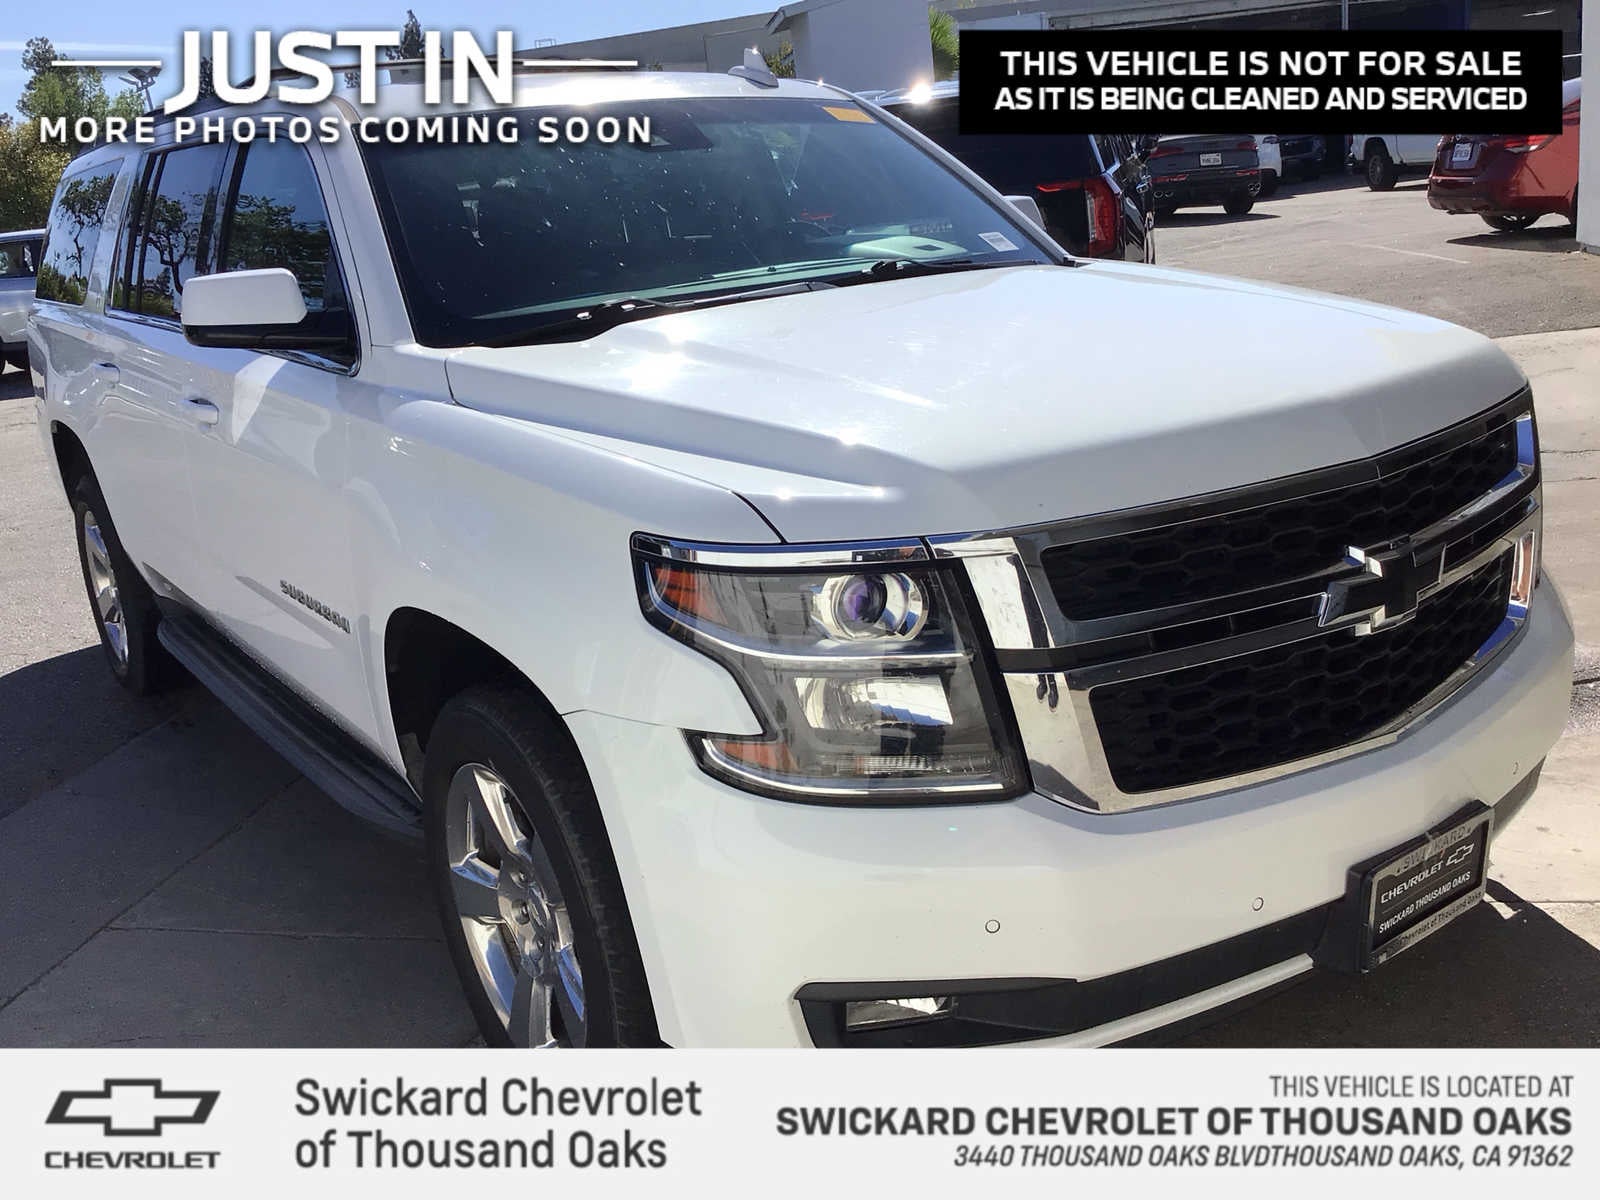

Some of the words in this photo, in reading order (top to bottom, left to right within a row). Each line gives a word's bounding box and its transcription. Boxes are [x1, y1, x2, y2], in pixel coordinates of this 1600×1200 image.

[280, 580, 351, 633] SUBURBAN
[1379, 904, 1415, 933] SWICKARD
[1415, 881, 1452, 911] THOUSAND
[1452, 871, 1471, 888] OAKS
[1381, 861, 1443, 903] CHEVROLET
